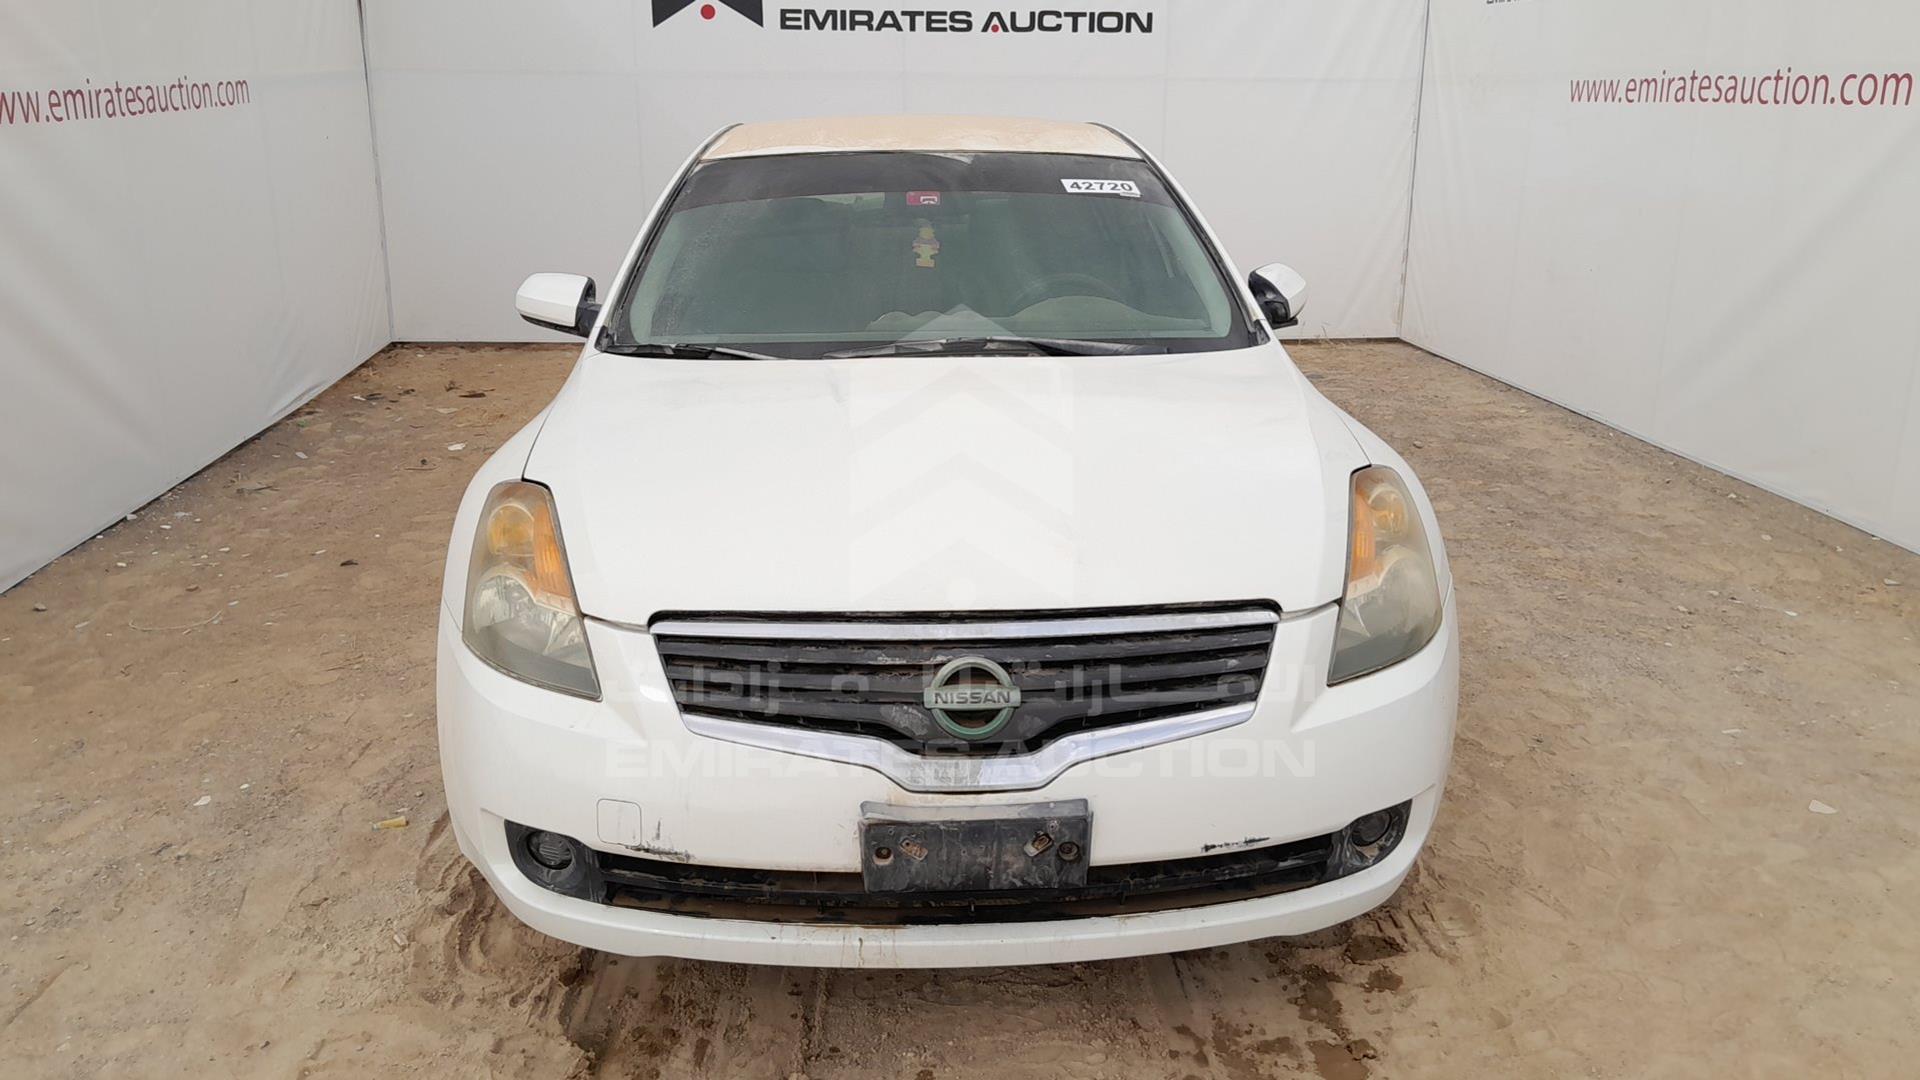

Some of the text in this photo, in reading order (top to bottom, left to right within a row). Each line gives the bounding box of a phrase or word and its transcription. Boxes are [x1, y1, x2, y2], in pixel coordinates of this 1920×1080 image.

[779, 8, 1153, 33] EMIRATES AUCTION
[1570, 67, 1913, 106] www.emiratesauction.com
[1069, 181, 1133, 192] 42720
[934, 691, 1010, 704] NISSAN
